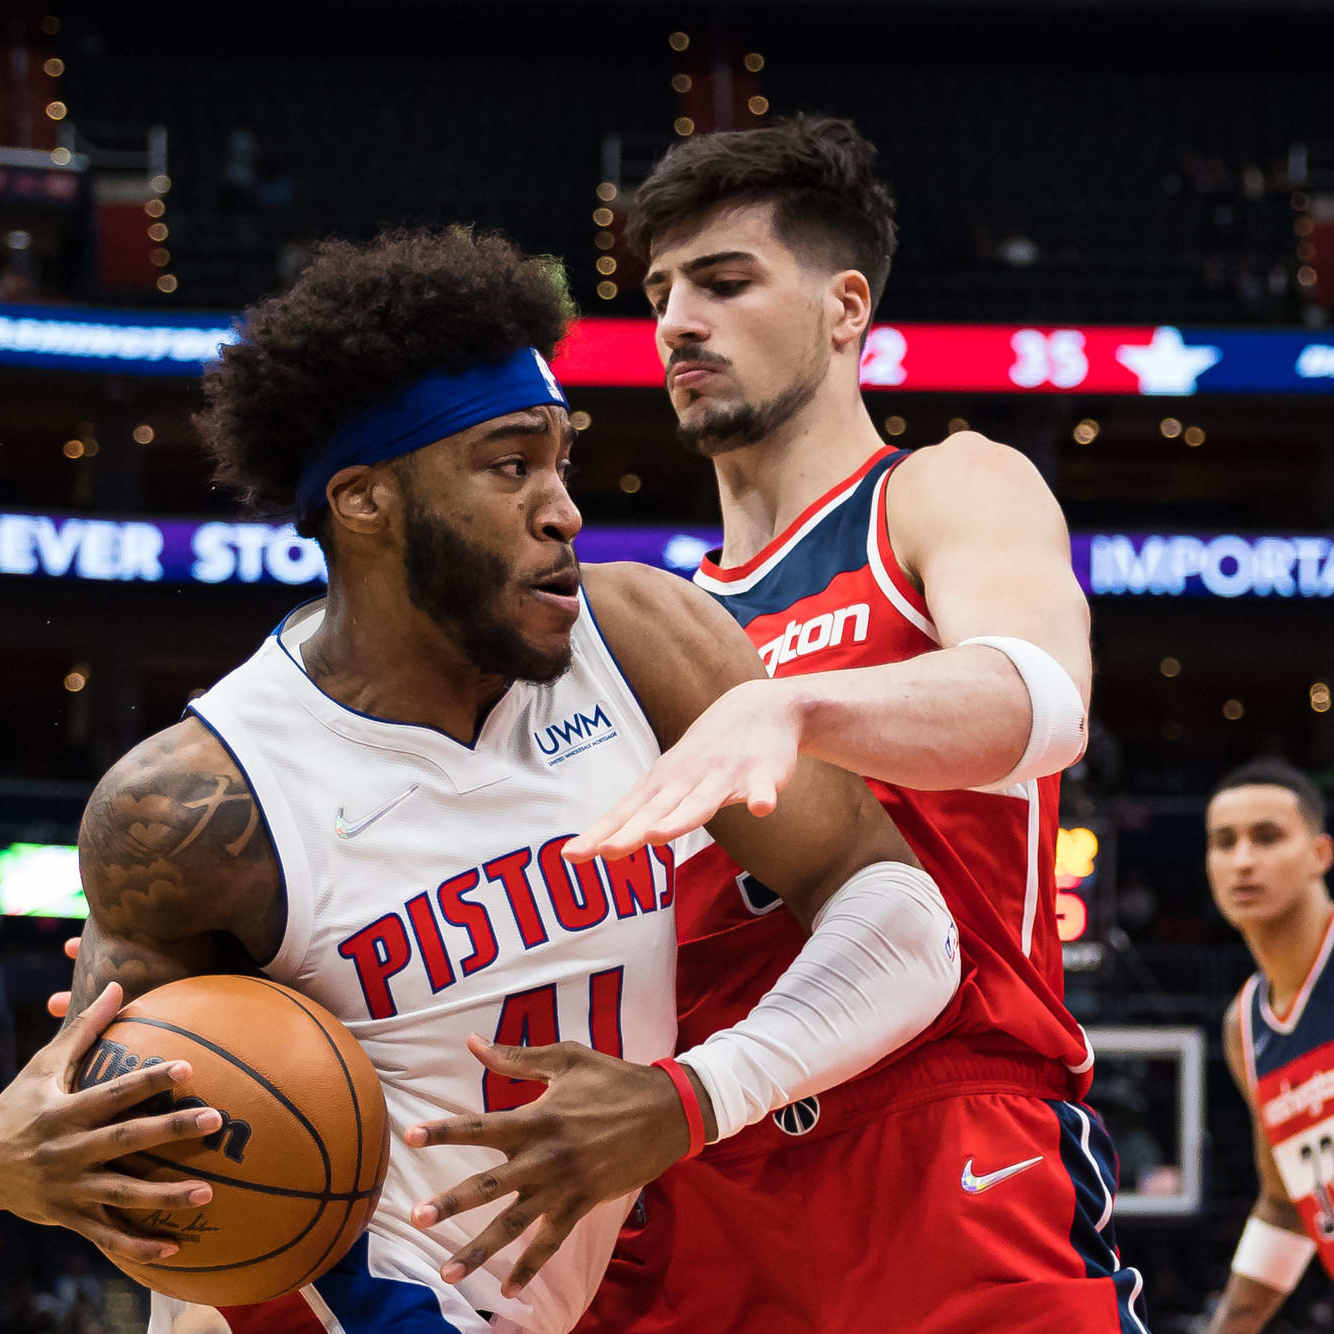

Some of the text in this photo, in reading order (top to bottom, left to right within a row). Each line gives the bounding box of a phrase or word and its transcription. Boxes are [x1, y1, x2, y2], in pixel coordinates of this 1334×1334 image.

[1009, 327, 1089, 389] 35
[191, 521, 327, 585] STO
[533, 703, 613, 755] UWM
